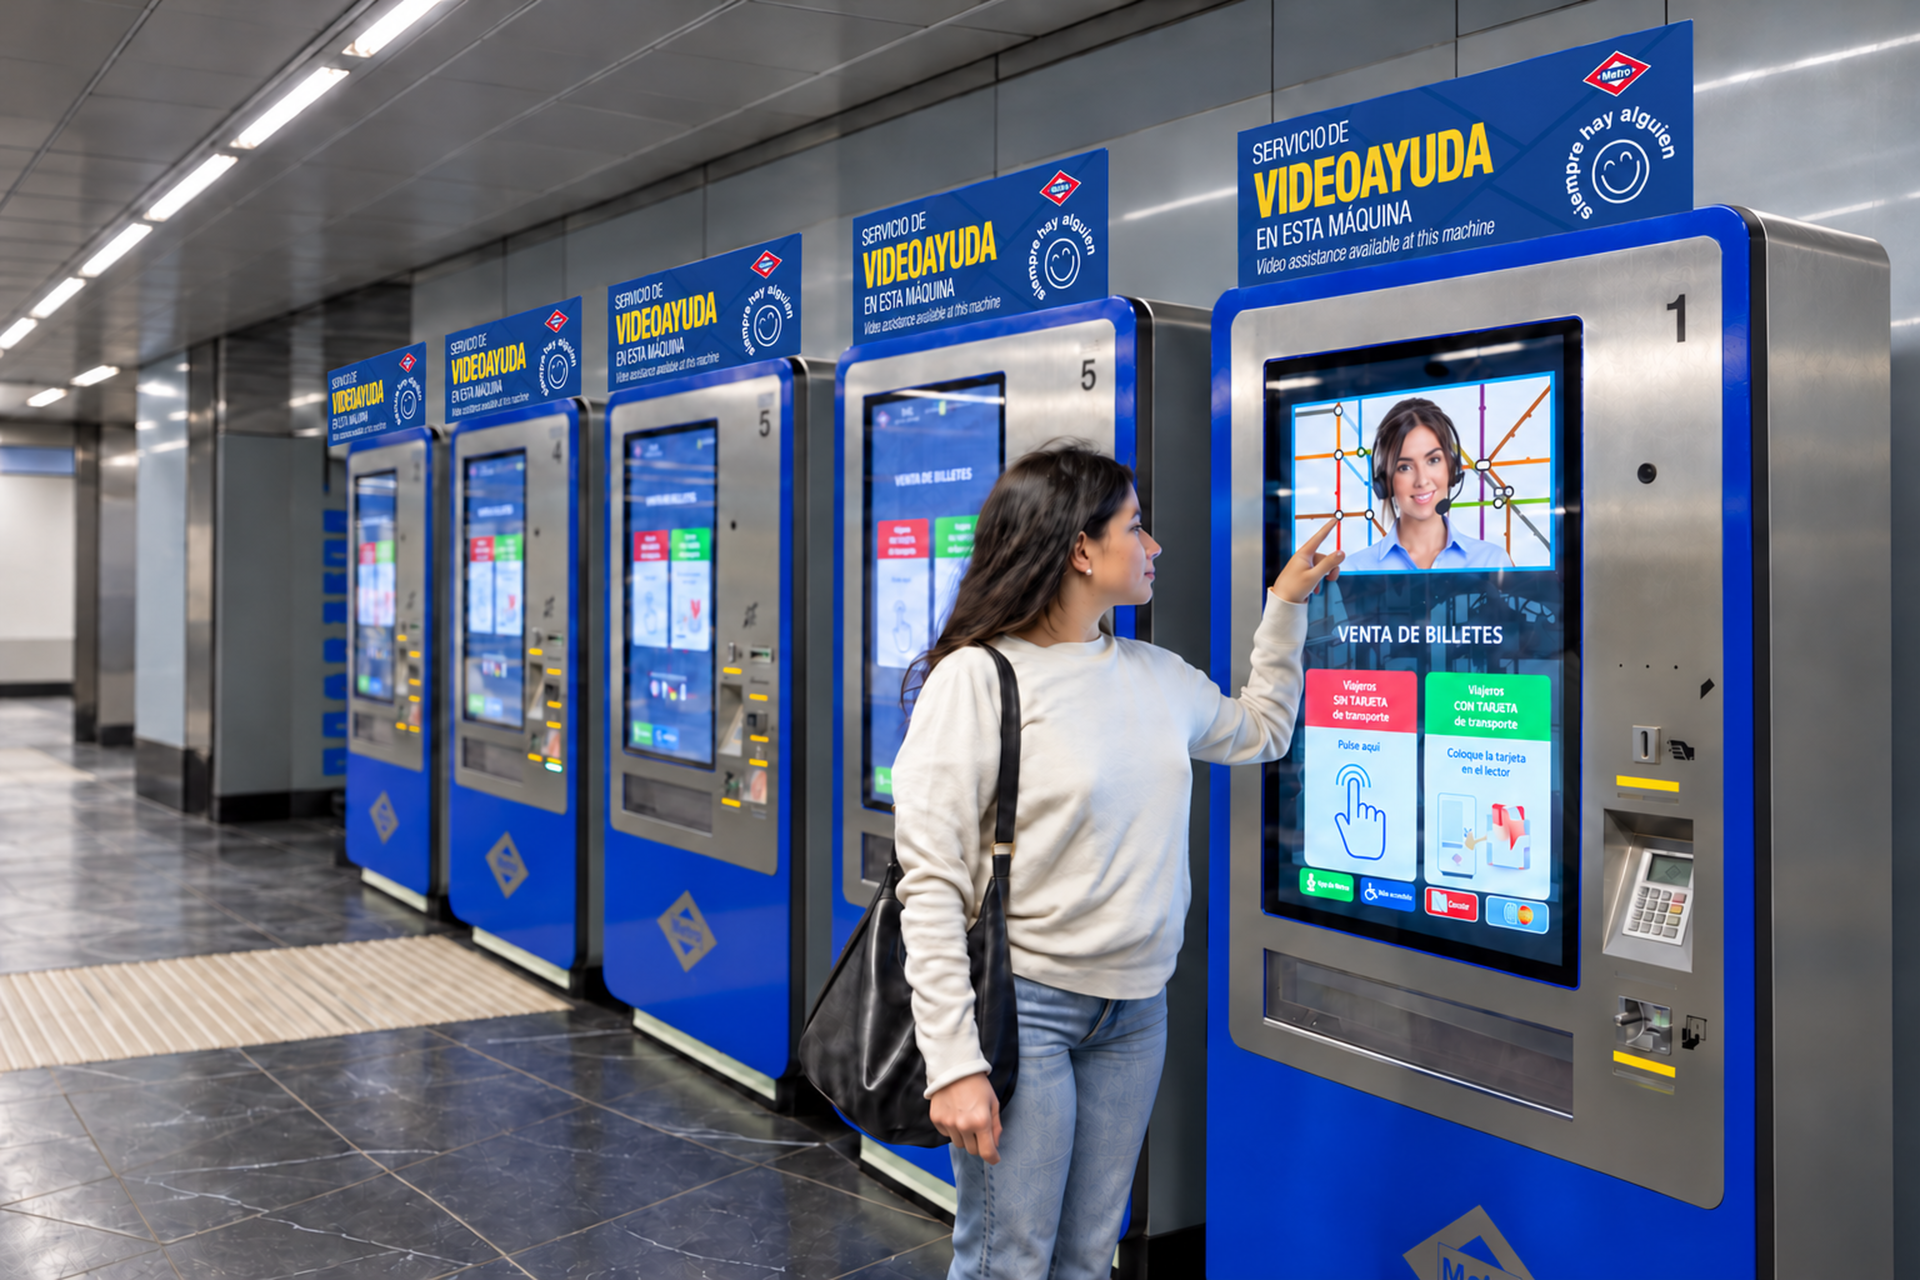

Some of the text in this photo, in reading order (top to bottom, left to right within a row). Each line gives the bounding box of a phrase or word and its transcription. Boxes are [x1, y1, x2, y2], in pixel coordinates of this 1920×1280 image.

[1252, 120, 1349, 165] SERVICIO DE
[1253, 122, 1494, 218] VIDEOAYUDA
[1565, 106, 1675, 220] siempre hay alguien
[862, 211, 926, 246] SERVICIO DE
[1036, 217, 1058, 239] hay
[1062, 213, 1095, 255] alguien
[1256, 199, 1412, 251] EN ESTA MÁQUINA
[862, 220, 998, 289] VIDEOAYUDA
[1256, 219, 1495, 275] Video assistance available at this machine
[614, 282, 663, 310] SERVICIO DE
[864, 277, 955, 315] EN ESTA MÁQUINA
[954, 300, 968, 317] this
[969, 295, 1001, 314] machine
[615, 291, 718, 345] VIDEOAYUDA
[1667, 294, 1686, 343] 1
[451, 341, 527, 385] VIDEOAYUDA
[615, 350, 627, 367] EN
[627, 345, 647, 365] ESTA
[1081, 358, 1096, 391] 5
[759, 410, 771, 437] 5
[1337, 625, 1503, 645] VENTA DE BILLETES
[1333, 694, 1388, 708] SIN TARJETA
[1342, 680, 1377, 694] Viajeros
[1468, 684, 1505, 699] Viajeros
[1332, 709, 1344, 720] de
[1453, 700, 1518, 714] CON TARJETA
[1454, 715, 1519, 731] de transporte
[1337, 739, 1360, 751] Pulse
[1446, 747, 1527, 765] Coloque la tarjeta
[1461, 764, 1511, 777] en el lector
